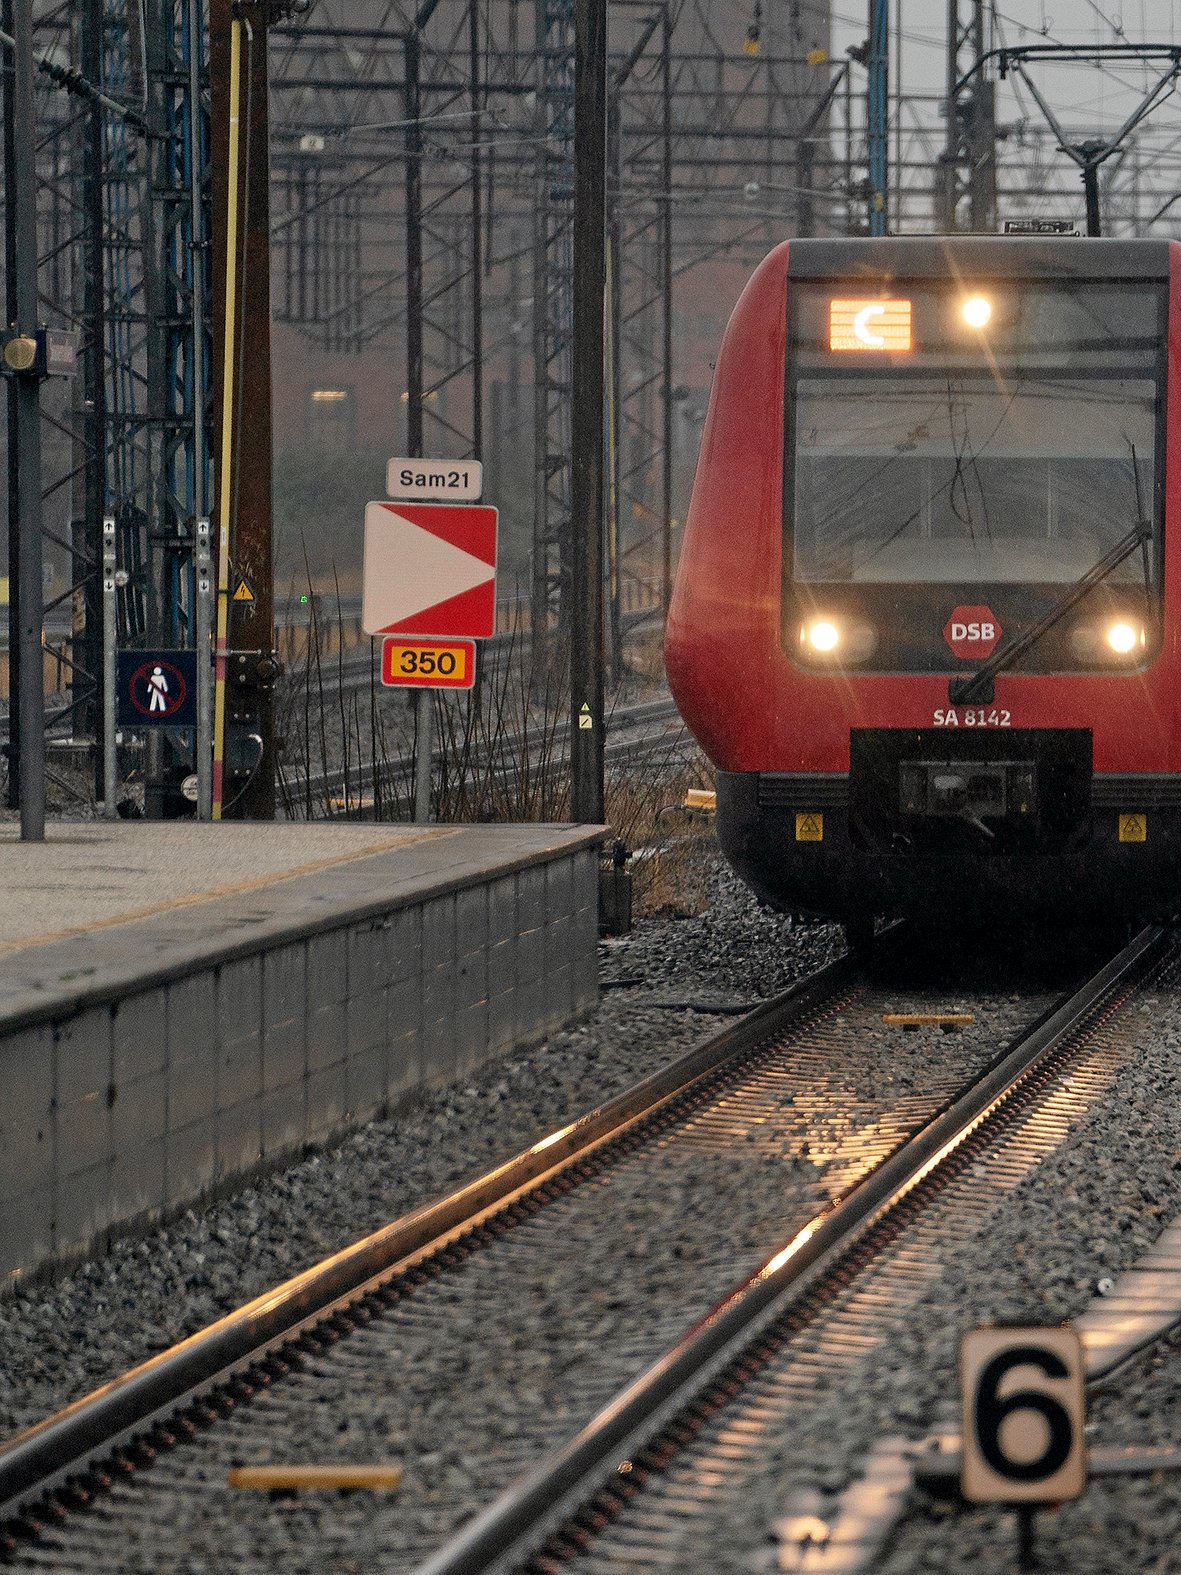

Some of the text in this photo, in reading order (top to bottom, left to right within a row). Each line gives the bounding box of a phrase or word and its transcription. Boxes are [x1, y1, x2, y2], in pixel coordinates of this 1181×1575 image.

[854, 305, 885, 345] C
[399, 469, 469, 488] Sam21
[951, 623, 995, 641] DSB
[400, 650, 456, 675] 350
[933, 709, 1011, 727] SA 8142
[972, 1344, 1074, 1485] 6
